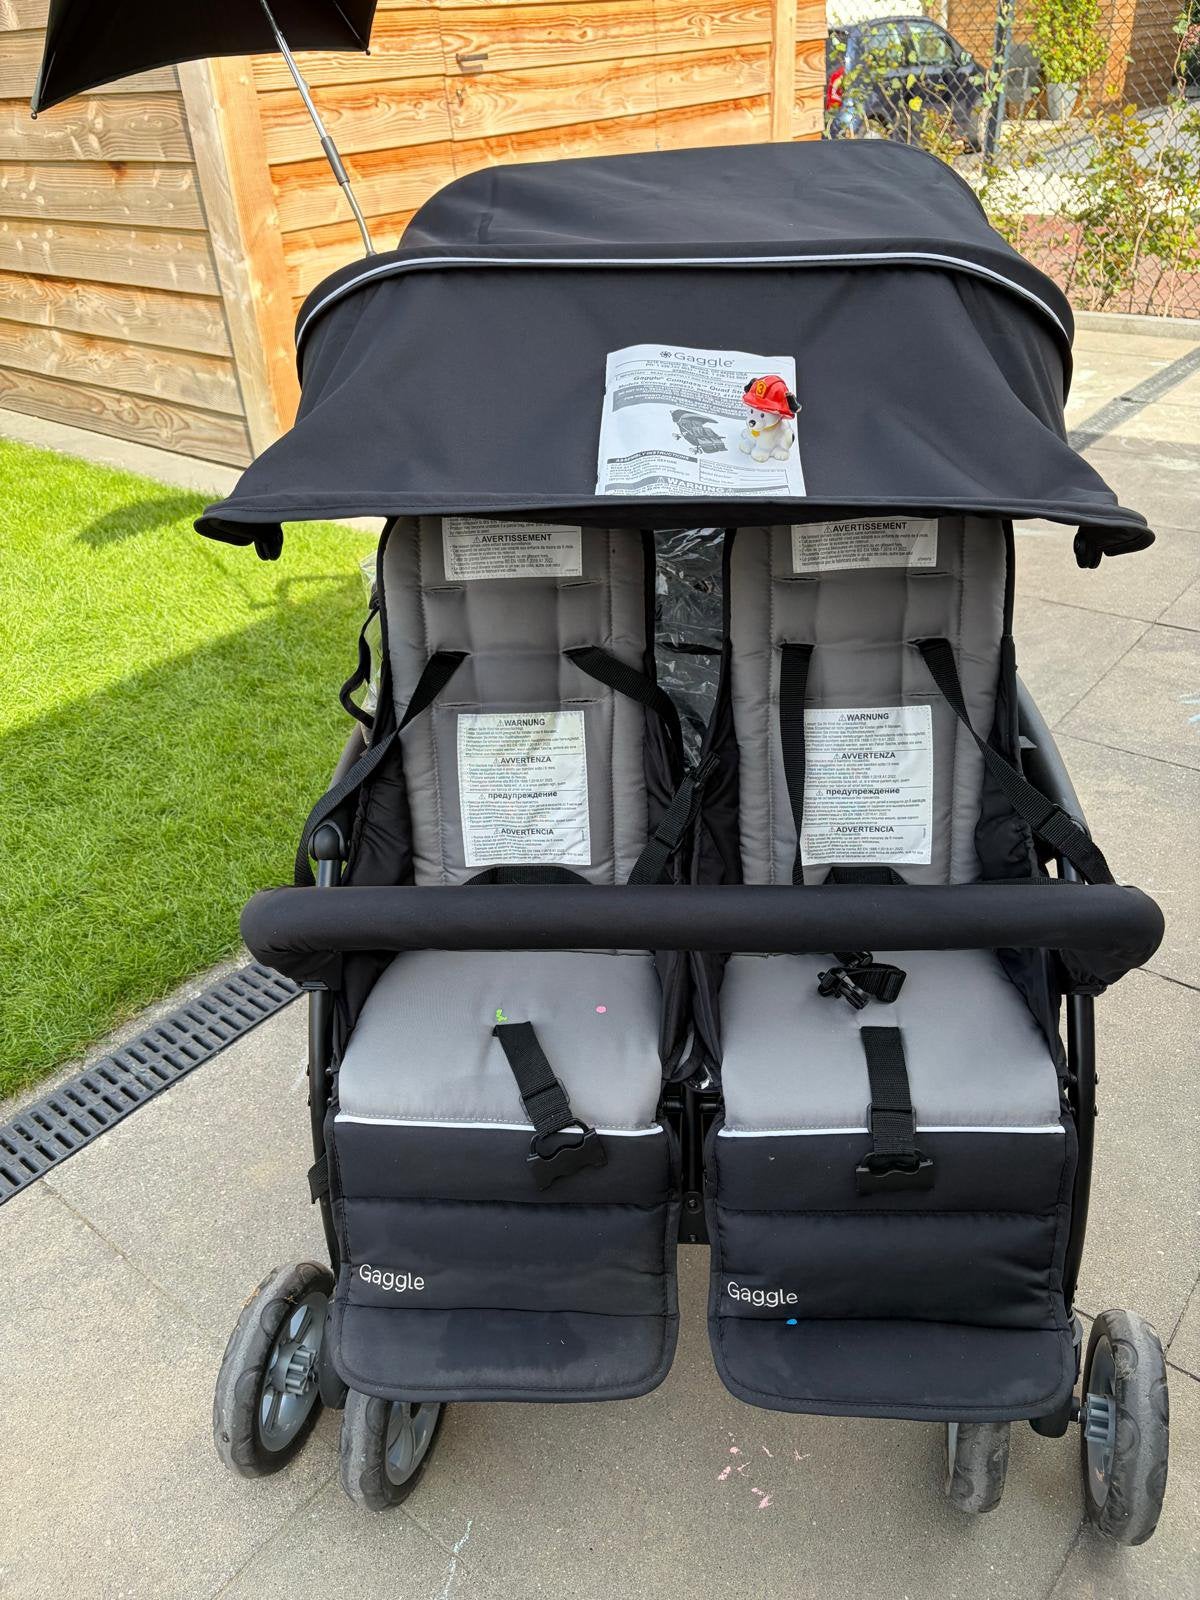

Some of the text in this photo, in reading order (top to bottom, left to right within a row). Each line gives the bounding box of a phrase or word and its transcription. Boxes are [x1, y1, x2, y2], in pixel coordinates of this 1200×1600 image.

[674, 352, 733, 368] Gaggle
[756, 383, 765, 395] 3
[667, 477, 725, 494] WARNING
[833, 522, 907, 533] AVERTISSEMENT
[482, 534, 552, 543] AVERTISSEMENT
[847, 713, 889, 721] WARNUNG
[504, 718, 545, 727] WARNUNG
[500, 756, 552, 764] AVVERTENZA
[841, 752, 896, 760] AVVERTENZA
[488, 791, 558, 801] предупреждение
[826, 788, 900, 796] предупреждение
[501, 828, 554, 836] ADVERTENCIA
[836, 825, 895, 833] ADVERTENCIA
[359, 1263, 425, 1293] Gaggle
[727, 1281, 799, 1308] Gaggle
